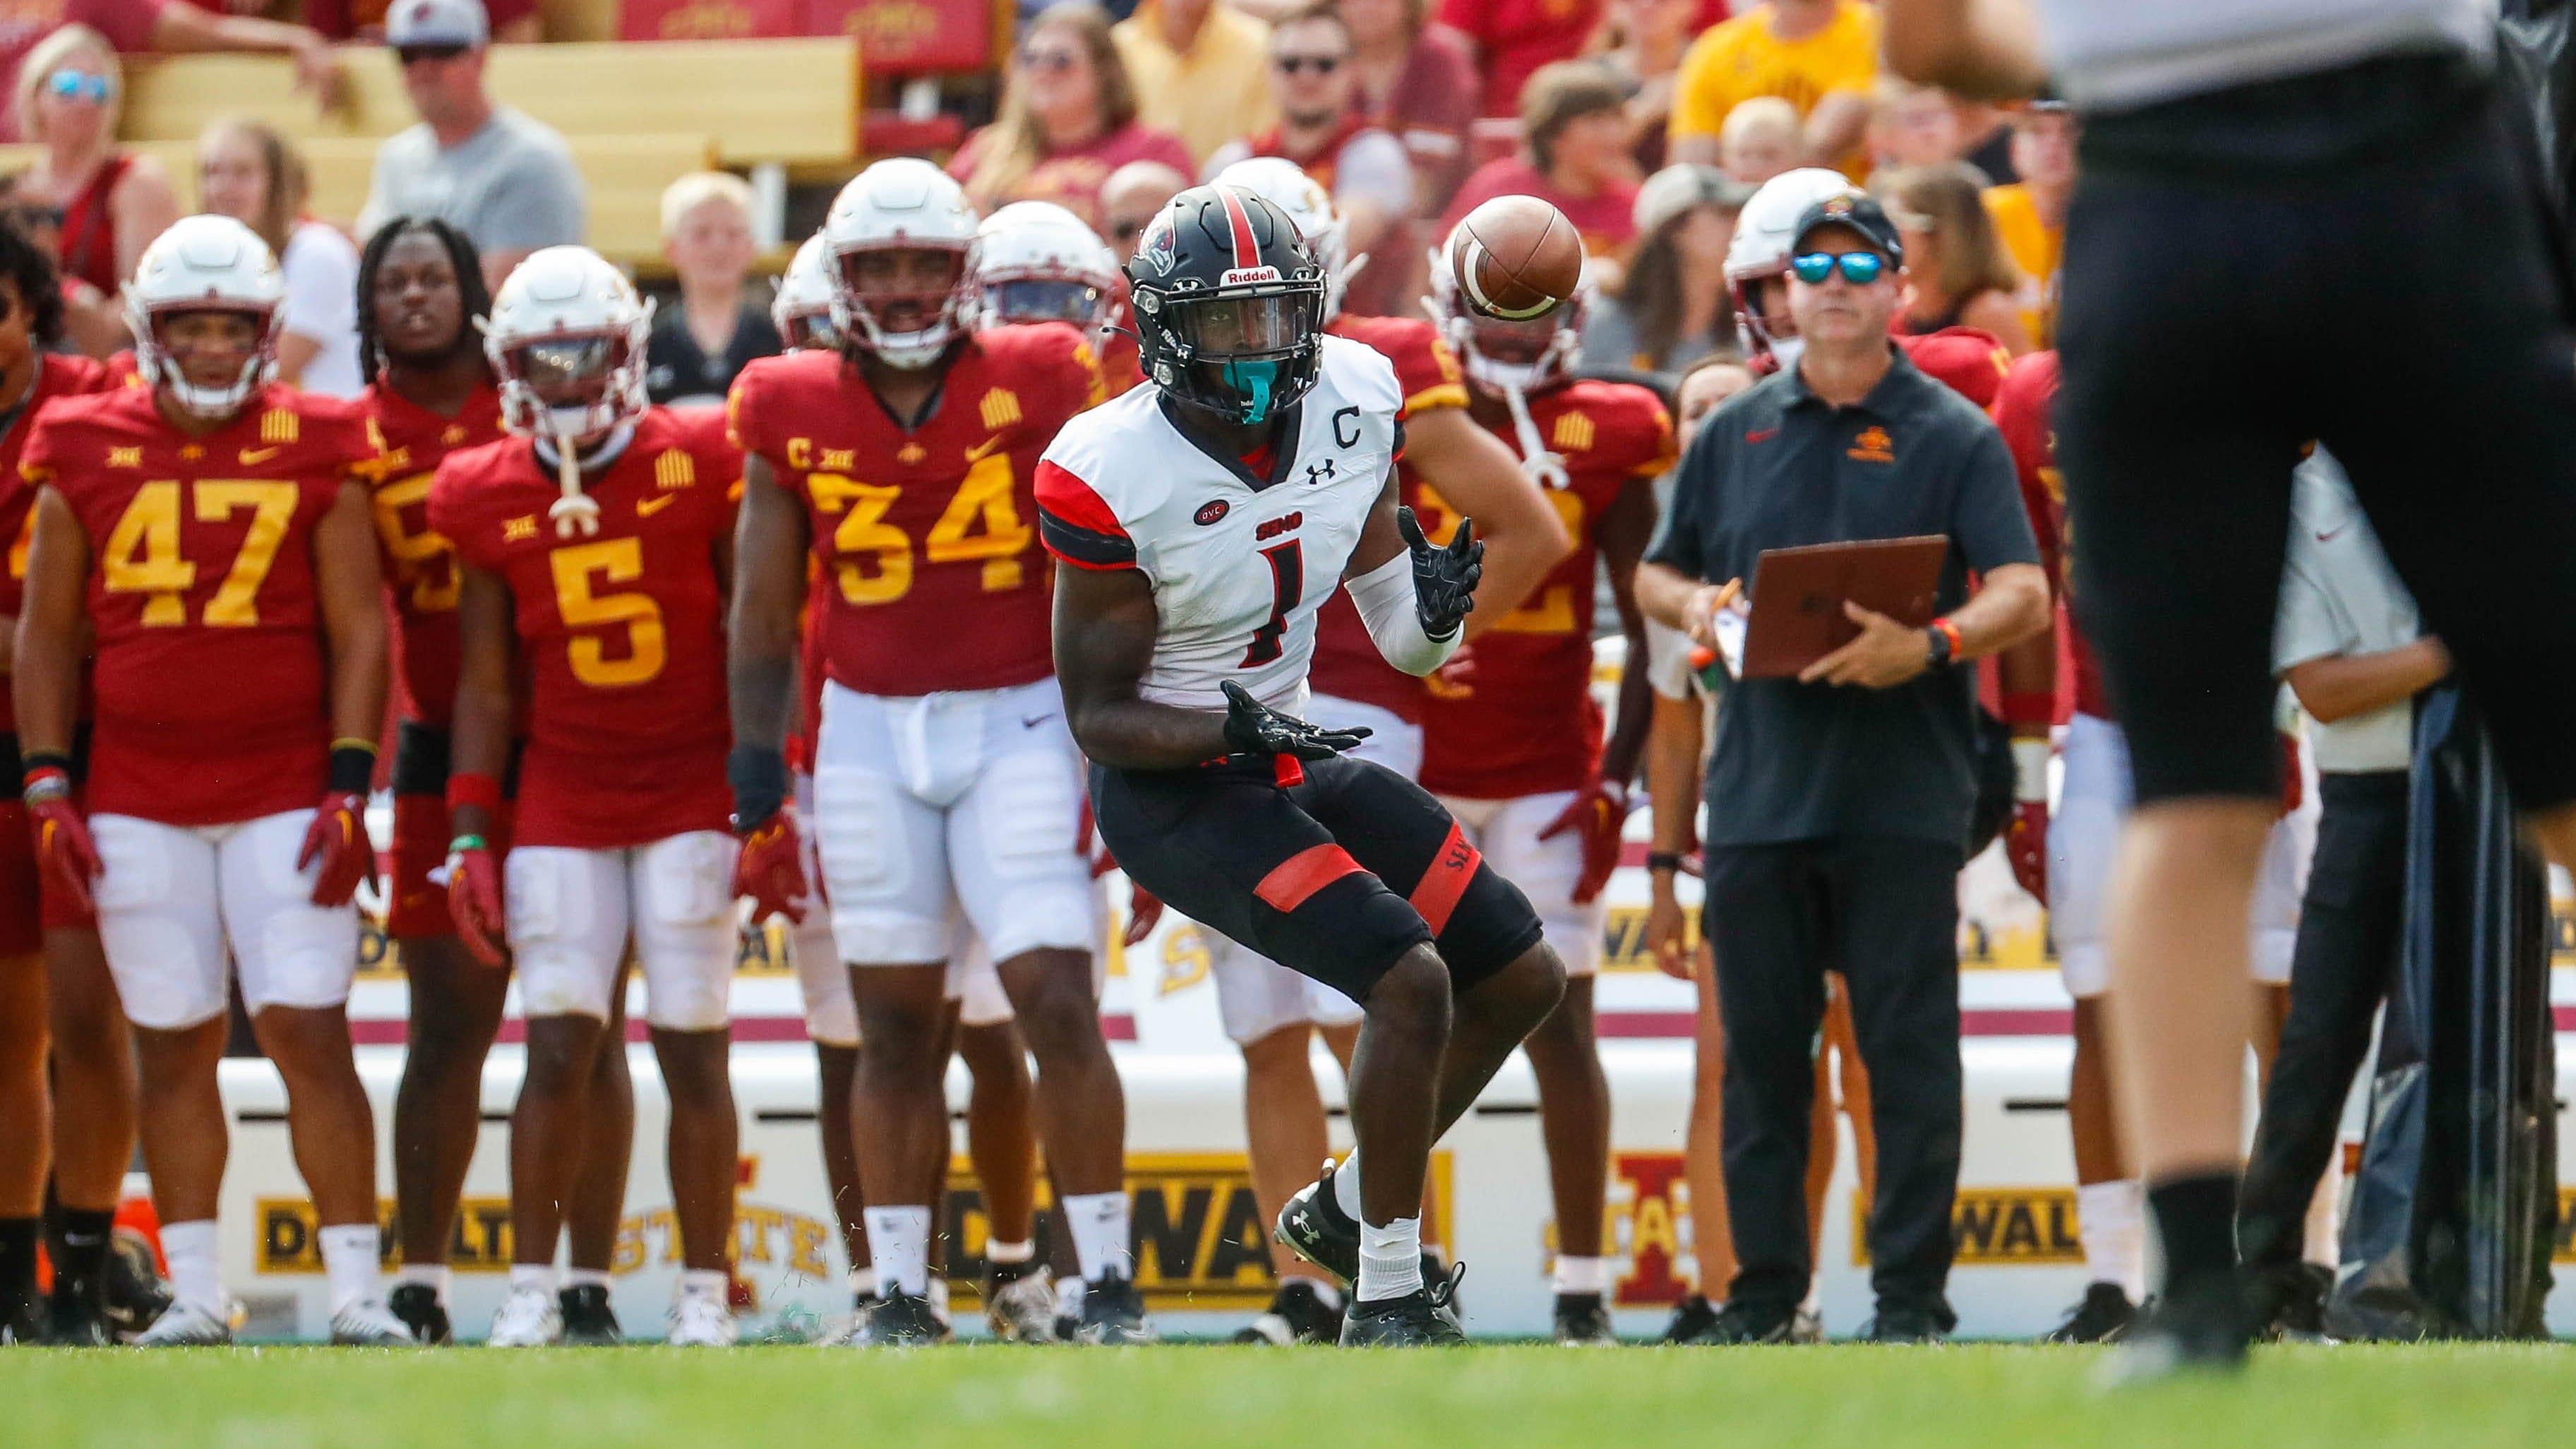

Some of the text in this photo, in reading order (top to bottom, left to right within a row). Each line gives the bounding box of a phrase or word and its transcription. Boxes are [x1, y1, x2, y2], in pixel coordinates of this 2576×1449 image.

[1228, 270, 1275, 283] Riddell
[787, 436, 812, 469] C
[1332, 405, 1361, 450] C
[807, 452, 1034, 607] 34
[1202, 506, 1221, 520] OVC
[1255, 511, 1303, 542] SEMO
[103, 479, 299, 627] 47
[549, 536, 667, 688] 5
[1238, 537, 1303, 669] 1
[609, 1205, 829, 1280] STTE
